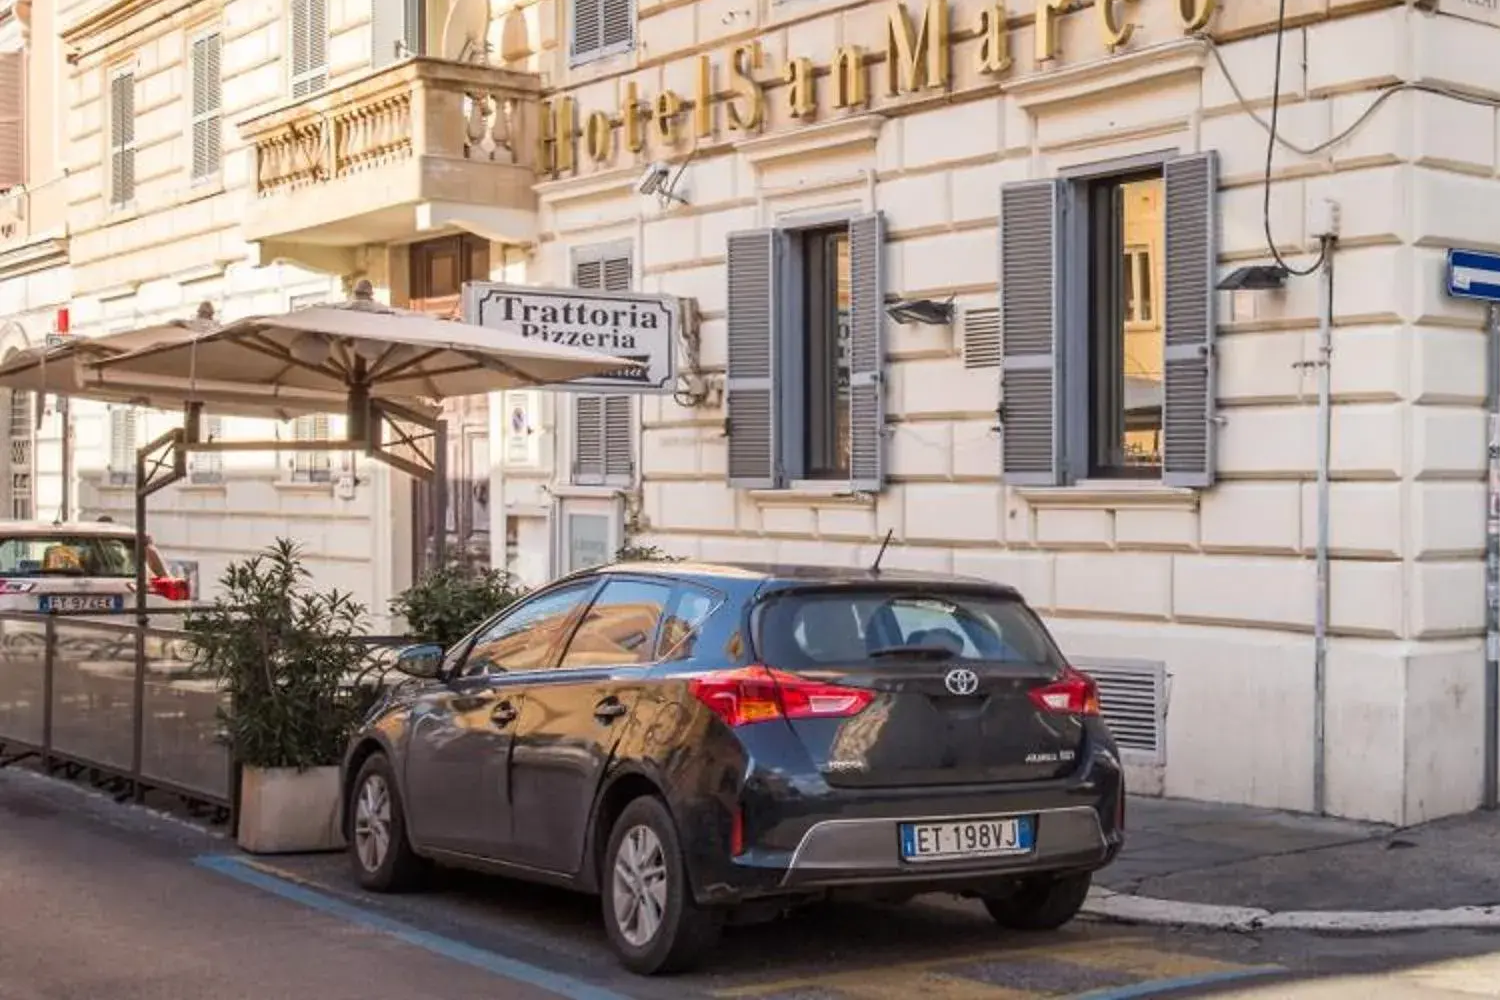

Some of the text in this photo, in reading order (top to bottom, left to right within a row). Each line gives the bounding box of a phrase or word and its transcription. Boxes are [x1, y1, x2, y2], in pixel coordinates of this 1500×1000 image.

[495, 295, 658, 330] Trattoria
[521, 323, 636, 349] Pizzeria
[916, 822, 1019, 853] ET 198VJ
